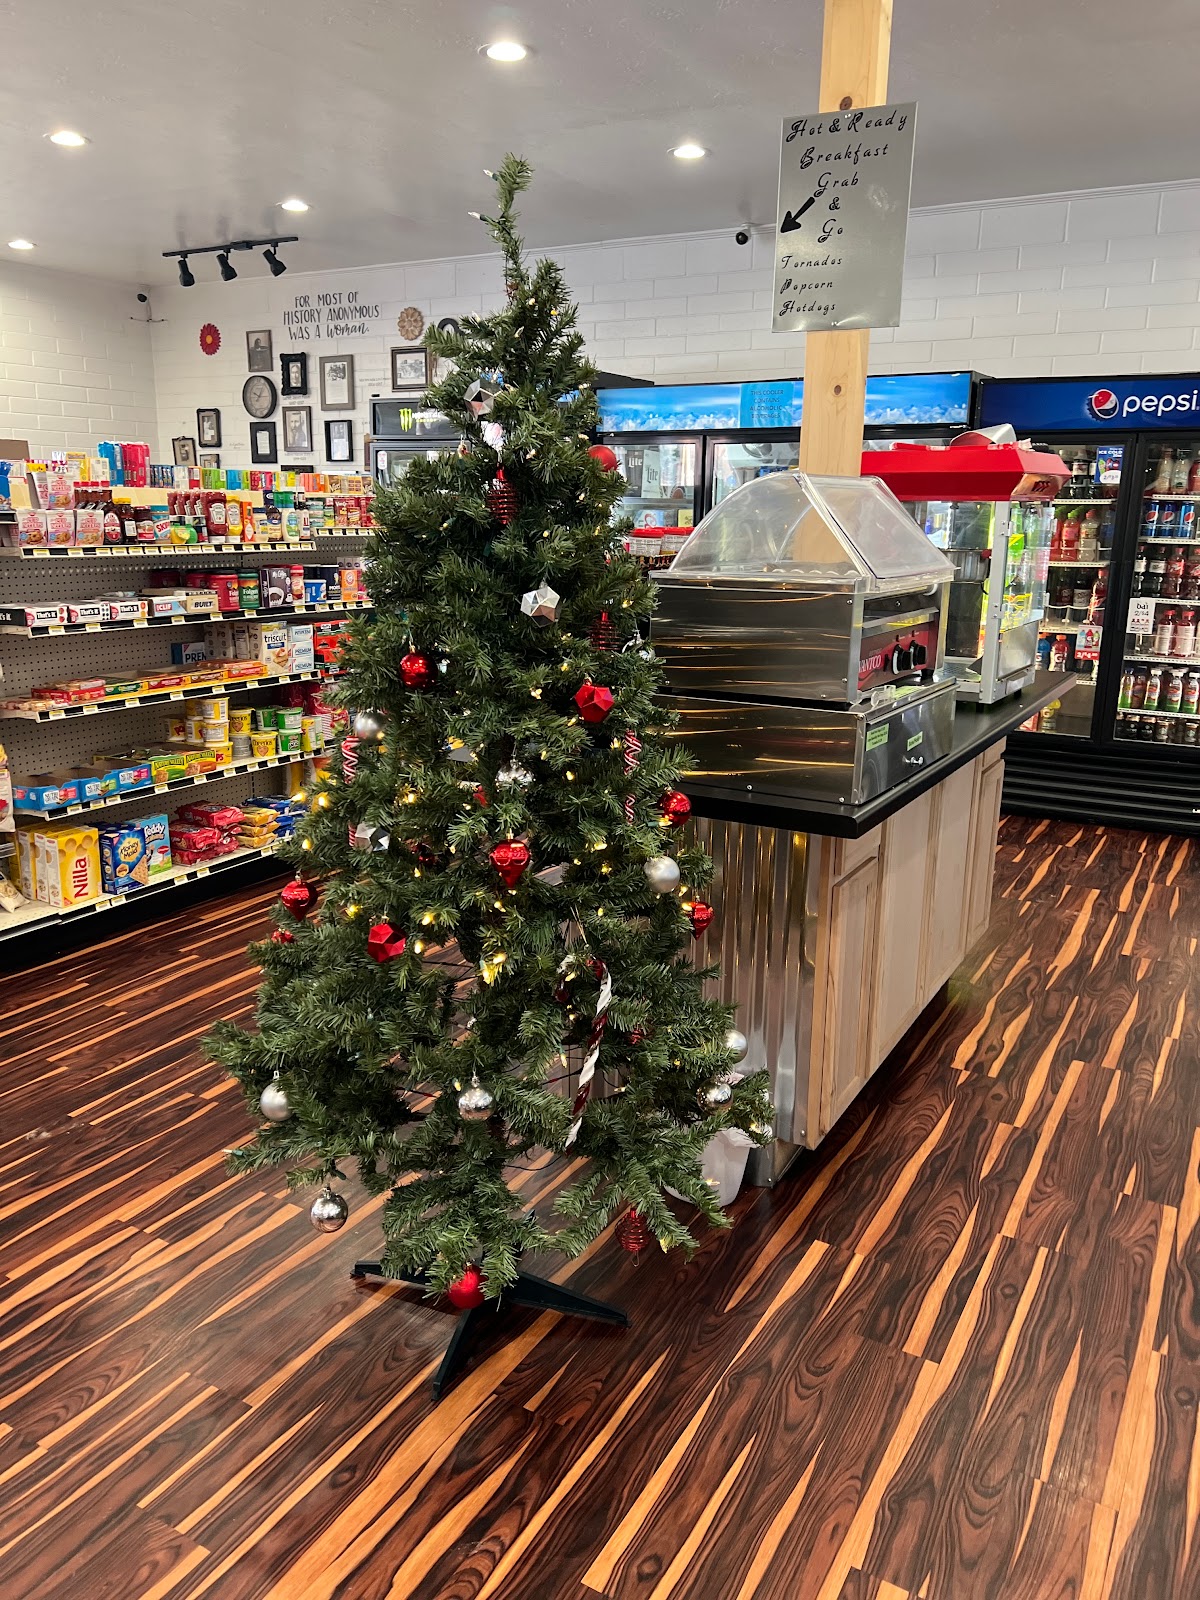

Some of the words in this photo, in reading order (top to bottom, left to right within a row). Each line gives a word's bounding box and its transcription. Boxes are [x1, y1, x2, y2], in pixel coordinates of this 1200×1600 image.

[786, 119, 822, 143] Hot
[828, 118, 841, 133] &
[848, 110, 908, 133] Ready
[800, 143, 888, 169] Breakfast
[814, 172, 858, 197] Grab
[828, 197, 840, 210] &
[817, 218, 843, 243] Go
[781, 255, 842, 269] Tornados
[780, 278, 833, 295] Popcorn
[295, 294, 310, 308] FOR
[318, 293, 343, 306] MOST
[347, 291, 359, 304] OF
[283, 309, 322, 325] HISTORY
[327, 305, 380, 322] ANONYMOUS
[779, 300, 836, 317] Hotdogs
[288, 326, 310, 340] WAS
[315, 325, 321, 339] A
[628, 457, 643, 468] Lite
[646, 467, 659, 484] Lite
[264, 633, 287, 643] triscuit
[144, 823, 165, 837] Teddy
[120, 841, 139, 855] Honey
[123, 848, 138, 859] Maid
[72, 856, 89, 899] Nilla
